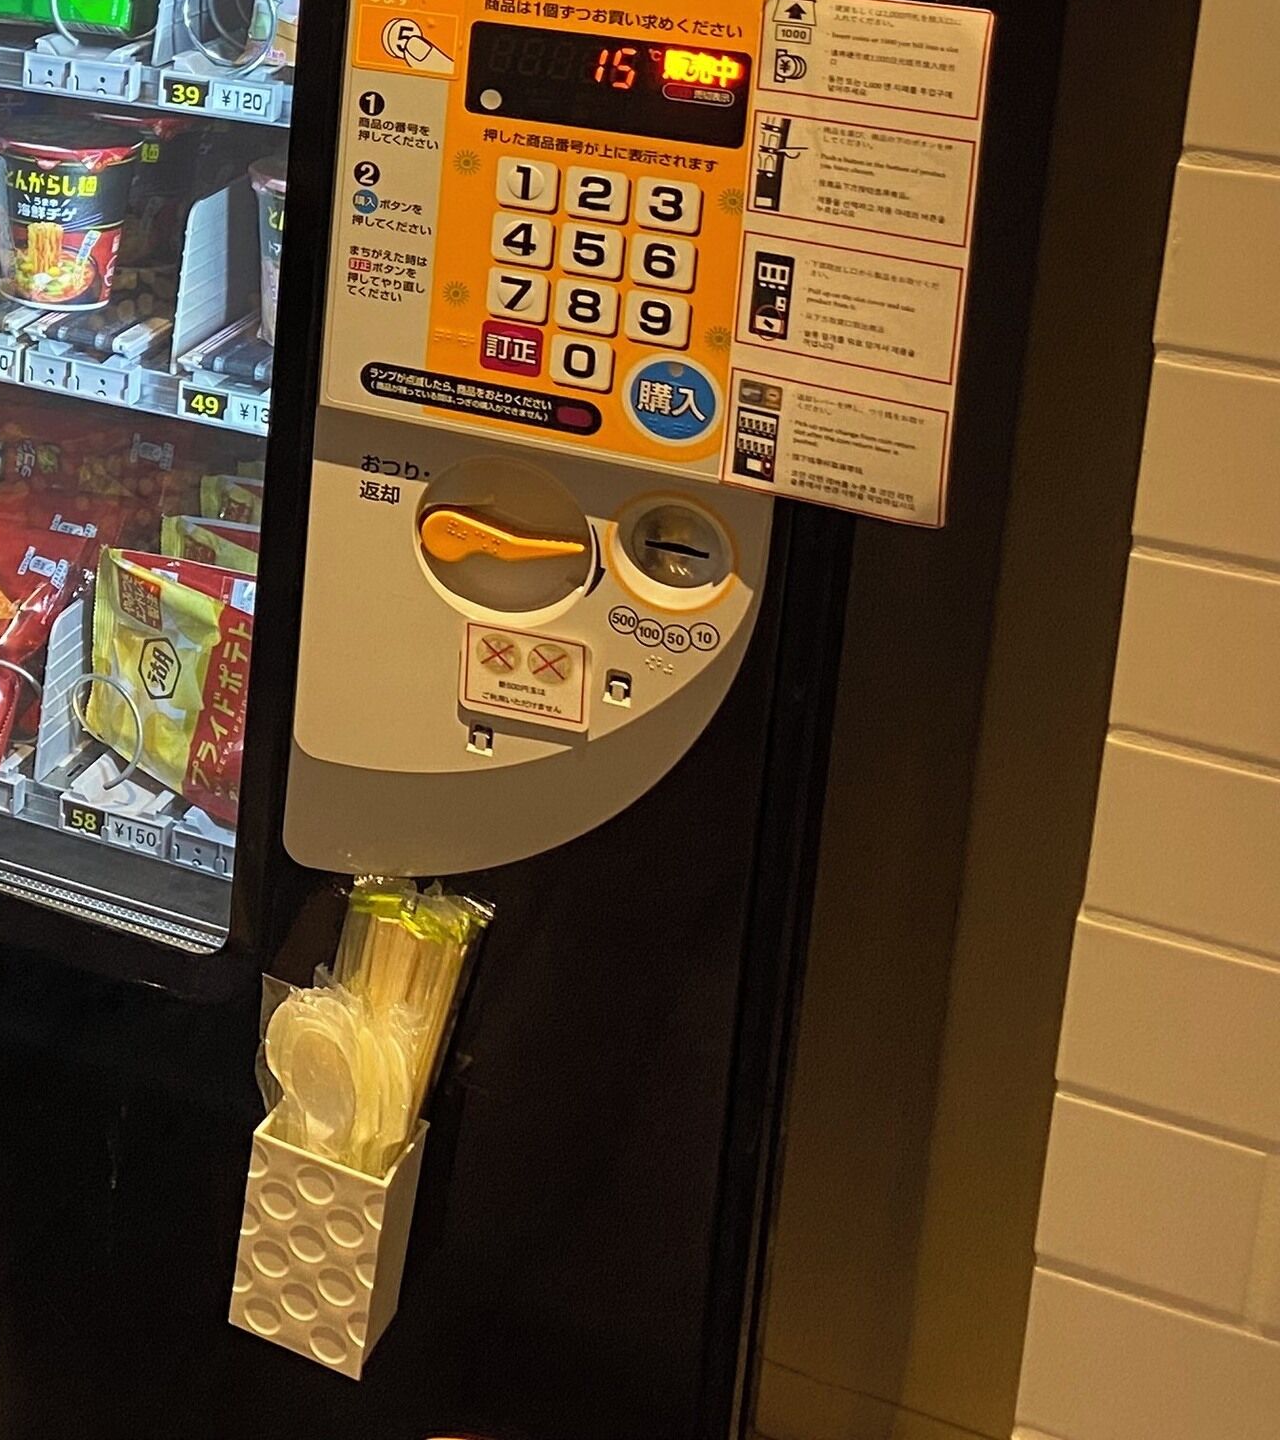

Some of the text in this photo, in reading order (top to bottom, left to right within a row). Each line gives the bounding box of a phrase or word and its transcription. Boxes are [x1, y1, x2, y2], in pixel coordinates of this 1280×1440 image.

[781, 29, 806, 40] 1000
[595, 48, 637, 89] 15
[663, 49, 741, 87] 販売中
[172, 84, 262, 112] 39 ¥120
[358, 130, 439, 150] 押してください
[359, 118, 430, 136] 商品の番号を
[483, 128, 719, 173] 押した商品番号が上に表示されます
[5, 170, 98, 196] とんがらし麺
[514, 165, 539, 201] 1
[578, 176, 610, 211] 2
[379, 200, 422, 215] ボタンを
[649, 186, 684, 222] 3
[352, 215, 432, 235] 押してください
[501, 222, 537, 257] 4
[349, 245, 428, 267] まちがえた時は
[572, 232, 607, 267] 5
[642, 242, 678, 278] 6
[347, 272, 425, 293] 押してやり直し
[372, 262, 417, 278] ボタンを
[347, 285, 402, 302] てください
[500, 277, 533, 312] 7
[567, 289, 602, 325] 8
[639, 300, 672, 336] 9
[486, 334, 706, 422] 訂正 0 購入
[191, 395, 218, 414] 49
[359, 480, 400, 505] 返却
[612, 613, 685, 646] 500 100 50
[192, 624, 252, 789] プライドポテト
[70, 809, 97, 831] 58
[114, 822, 156, 847] ¥150
